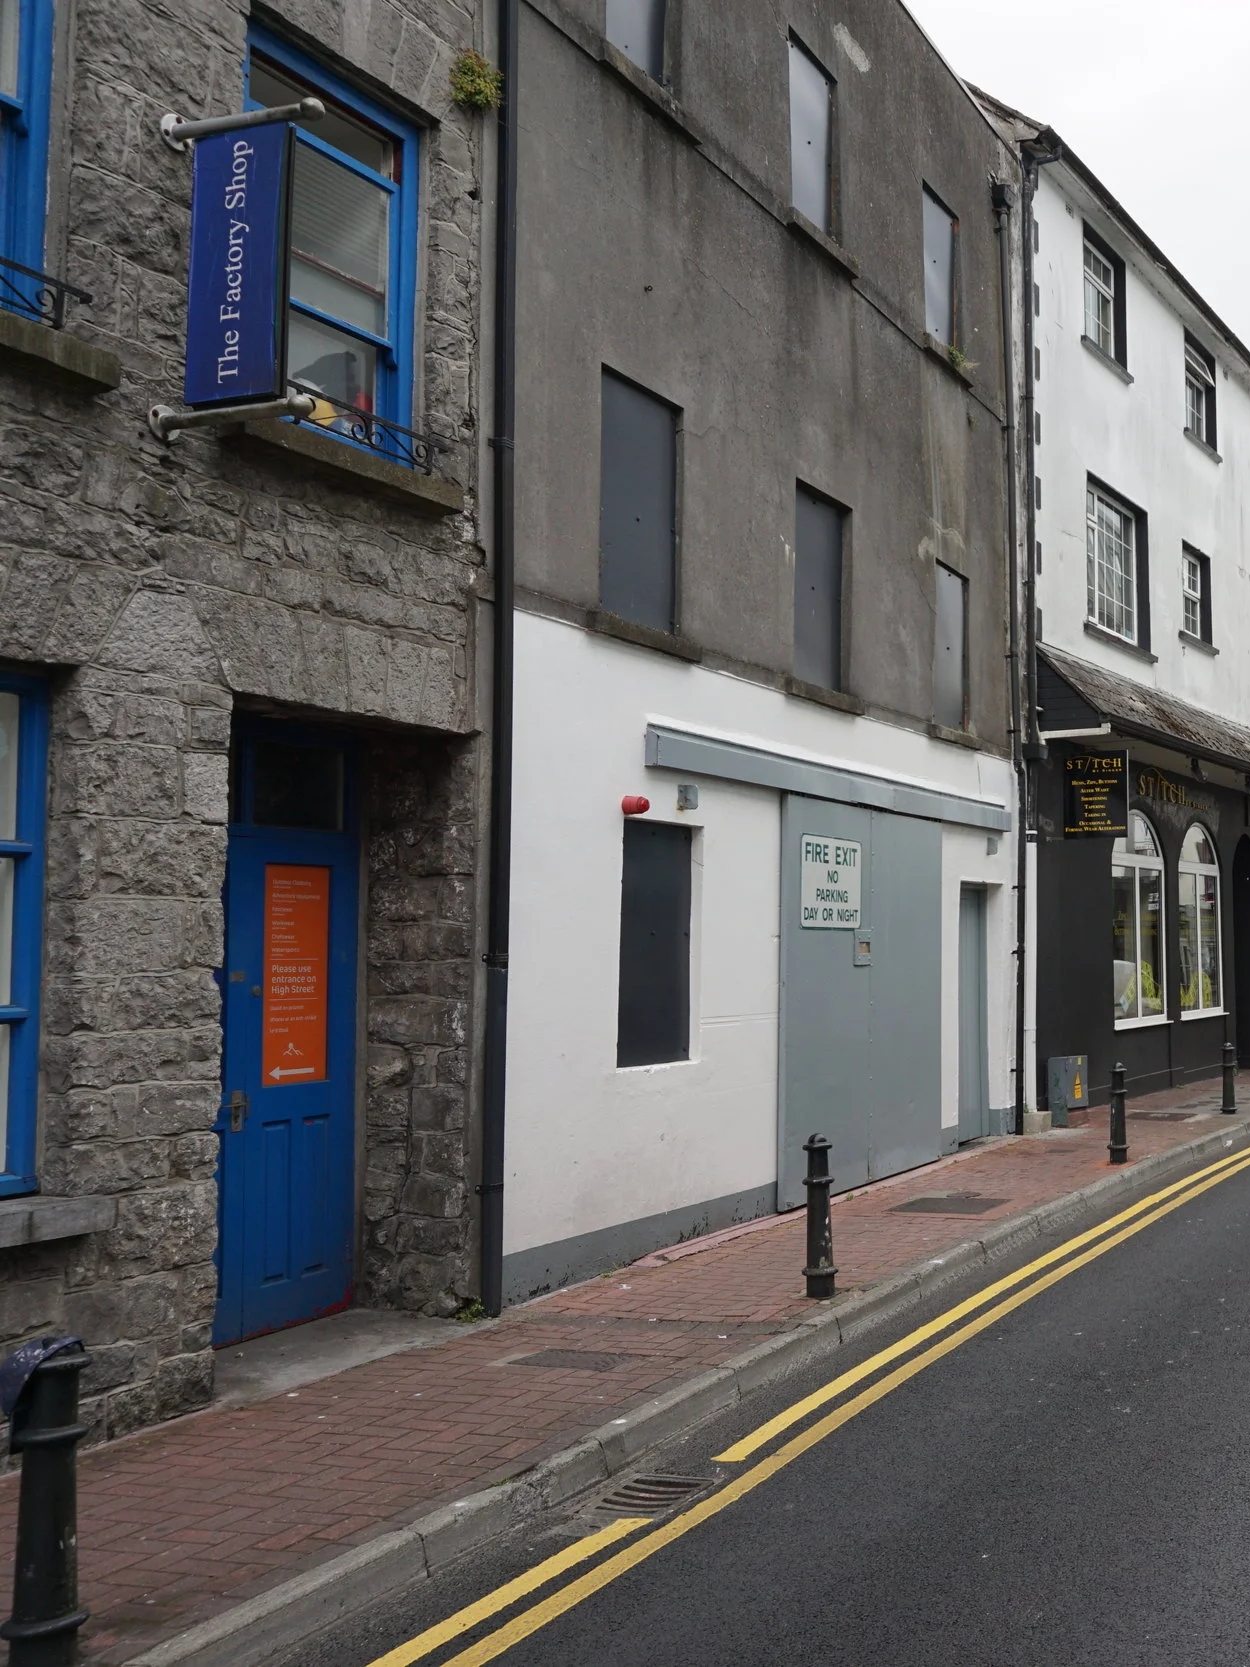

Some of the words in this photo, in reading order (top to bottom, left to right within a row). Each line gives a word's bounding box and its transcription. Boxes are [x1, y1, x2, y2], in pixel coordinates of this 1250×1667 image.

[225, 139, 254, 210] Shop
[220, 218, 250, 322] Factory
[217, 329, 240, 384] The
[805, 842, 829, 864] FIRE
[835, 846, 857, 867] EXIT
[827, 870, 839, 884] NO
[816, 888, 848, 903] PARKING
[804, 907, 818, 920] DAY
[822, 908, 834, 921] OR
[837, 909, 858, 922] NIGHT
[272, 965, 297, 973] Please
[272, 986, 290, 995] High
